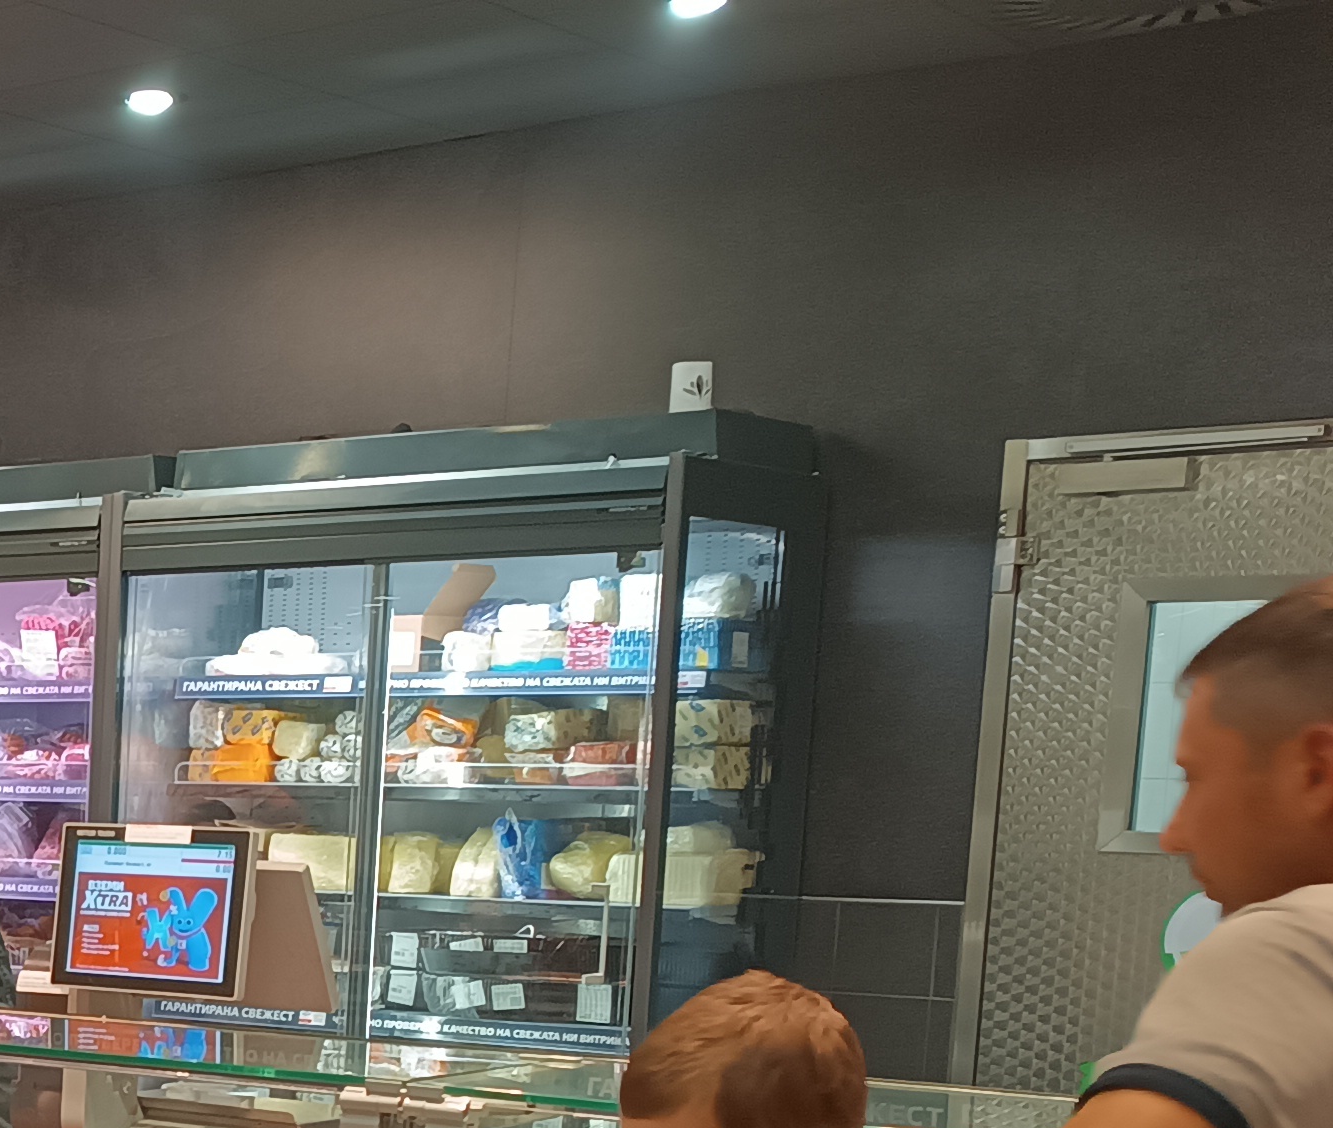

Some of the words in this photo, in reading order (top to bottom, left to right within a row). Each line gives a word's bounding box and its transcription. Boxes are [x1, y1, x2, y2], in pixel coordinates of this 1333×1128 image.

[183, 680, 263, 692] ГАРАНТИРАНА
[264, 679, 320, 691] СВЕЖЕСТ
[81, 890, 131, 910] XTRA
[160, 1001, 239, 1018] ГАРАНТИРАНА
[241, 1008, 295, 1021] СВЕЖЕСТ
[442, 1024, 495, 1036] КАЧЕСТВО
[496, 1028, 511, 1038] НА
[512, 1029, 560, 1041] СВЕЖАТА
[562, 1032, 578, 1042] НИ
